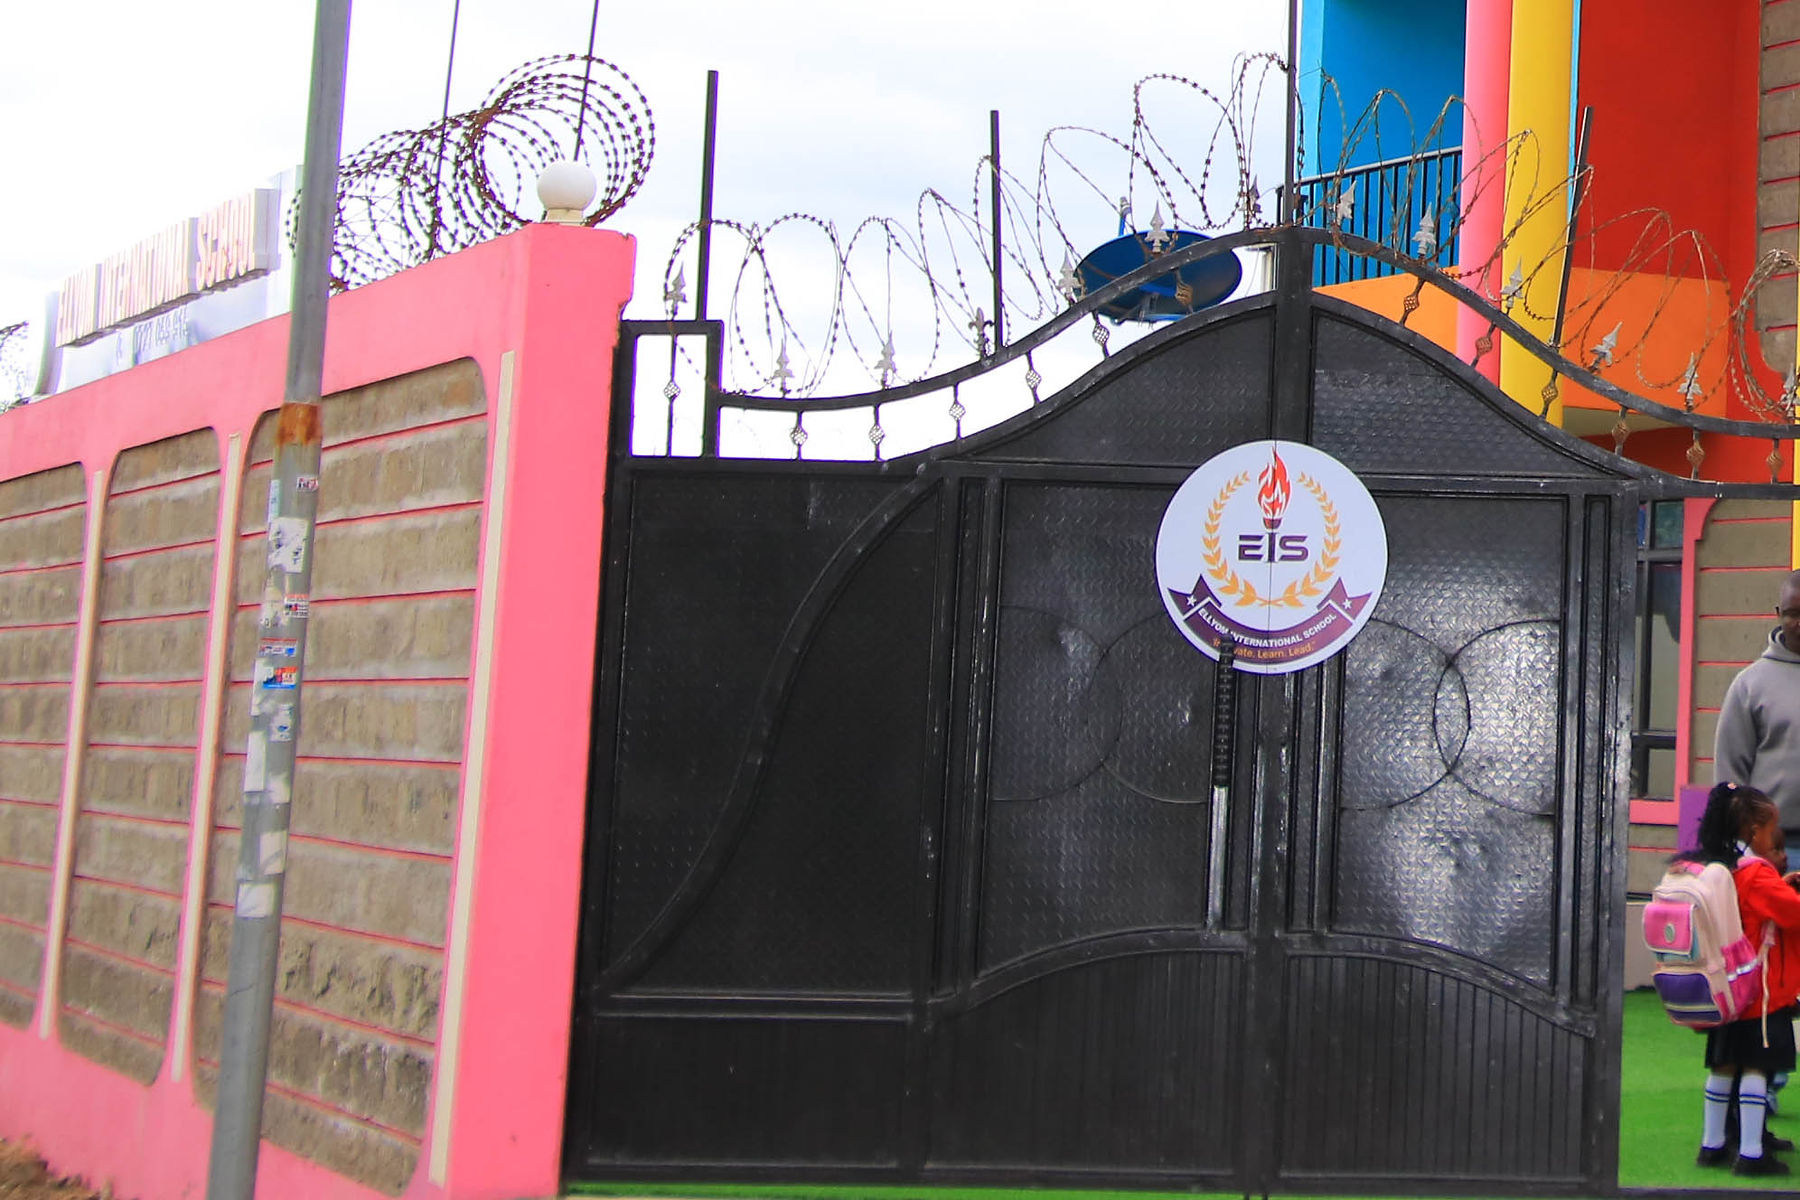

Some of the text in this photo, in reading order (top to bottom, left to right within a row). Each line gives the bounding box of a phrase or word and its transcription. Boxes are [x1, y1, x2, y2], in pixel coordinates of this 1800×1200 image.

[1238, 532, 1309, 563] EIS
[1198, 608, 1229, 634] ELLYOM
[1303, 613, 1337, 639] SCHOOL
